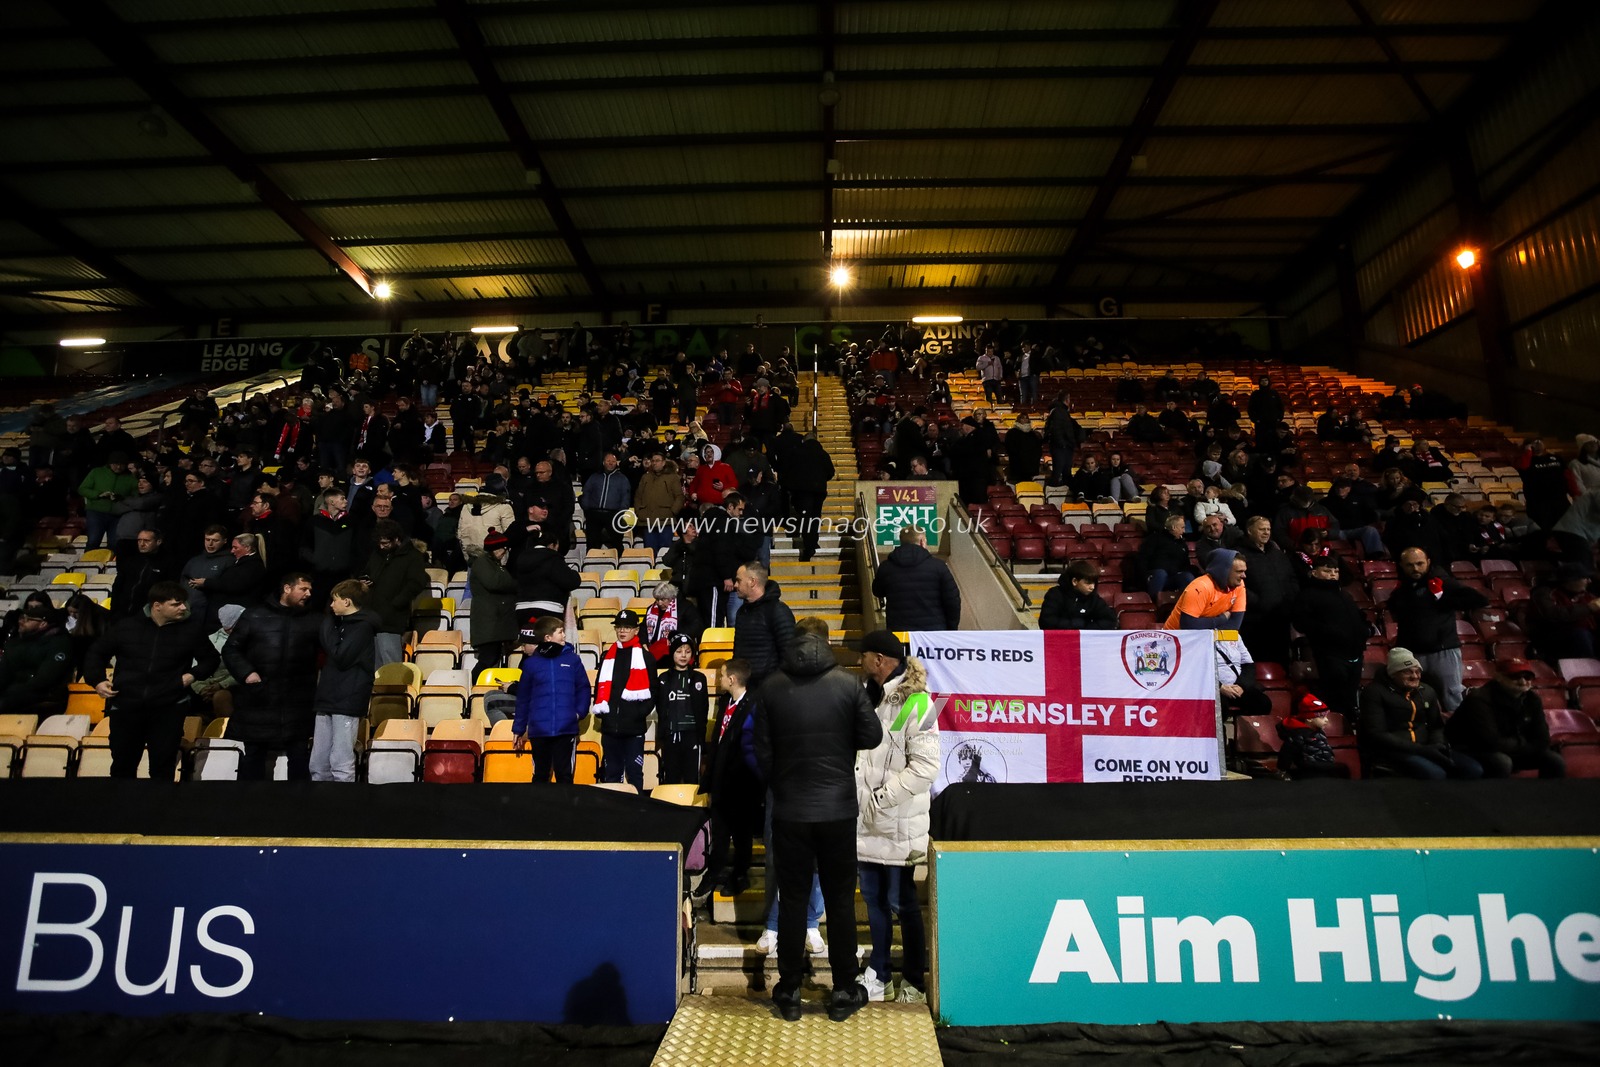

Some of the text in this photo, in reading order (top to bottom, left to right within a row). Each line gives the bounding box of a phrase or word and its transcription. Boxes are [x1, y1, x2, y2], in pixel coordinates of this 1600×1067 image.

[646, 304, 661, 322] F
[1100, 297, 1119, 316] G
[217, 318, 232, 336] E
[918, 325, 985, 340] ADING
[202, 343, 283, 358] LEADING
[201, 358, 250, 372] EDGE
[893, 489, 920, 502] V41
[879, 506, 935, 525] EXIT
[1130, 632, 1162, 641] BARNSLEY
[916, 646, 1034, 663] ALTOFTS REDS
[970, 701, 1159, 727] BARNSLEY FC
[1094, 759, 1209, 774] COME ON YOU
[16, 872, 255, 998] Bus
[1028, 893, 1600, 1001] Aim Highe
